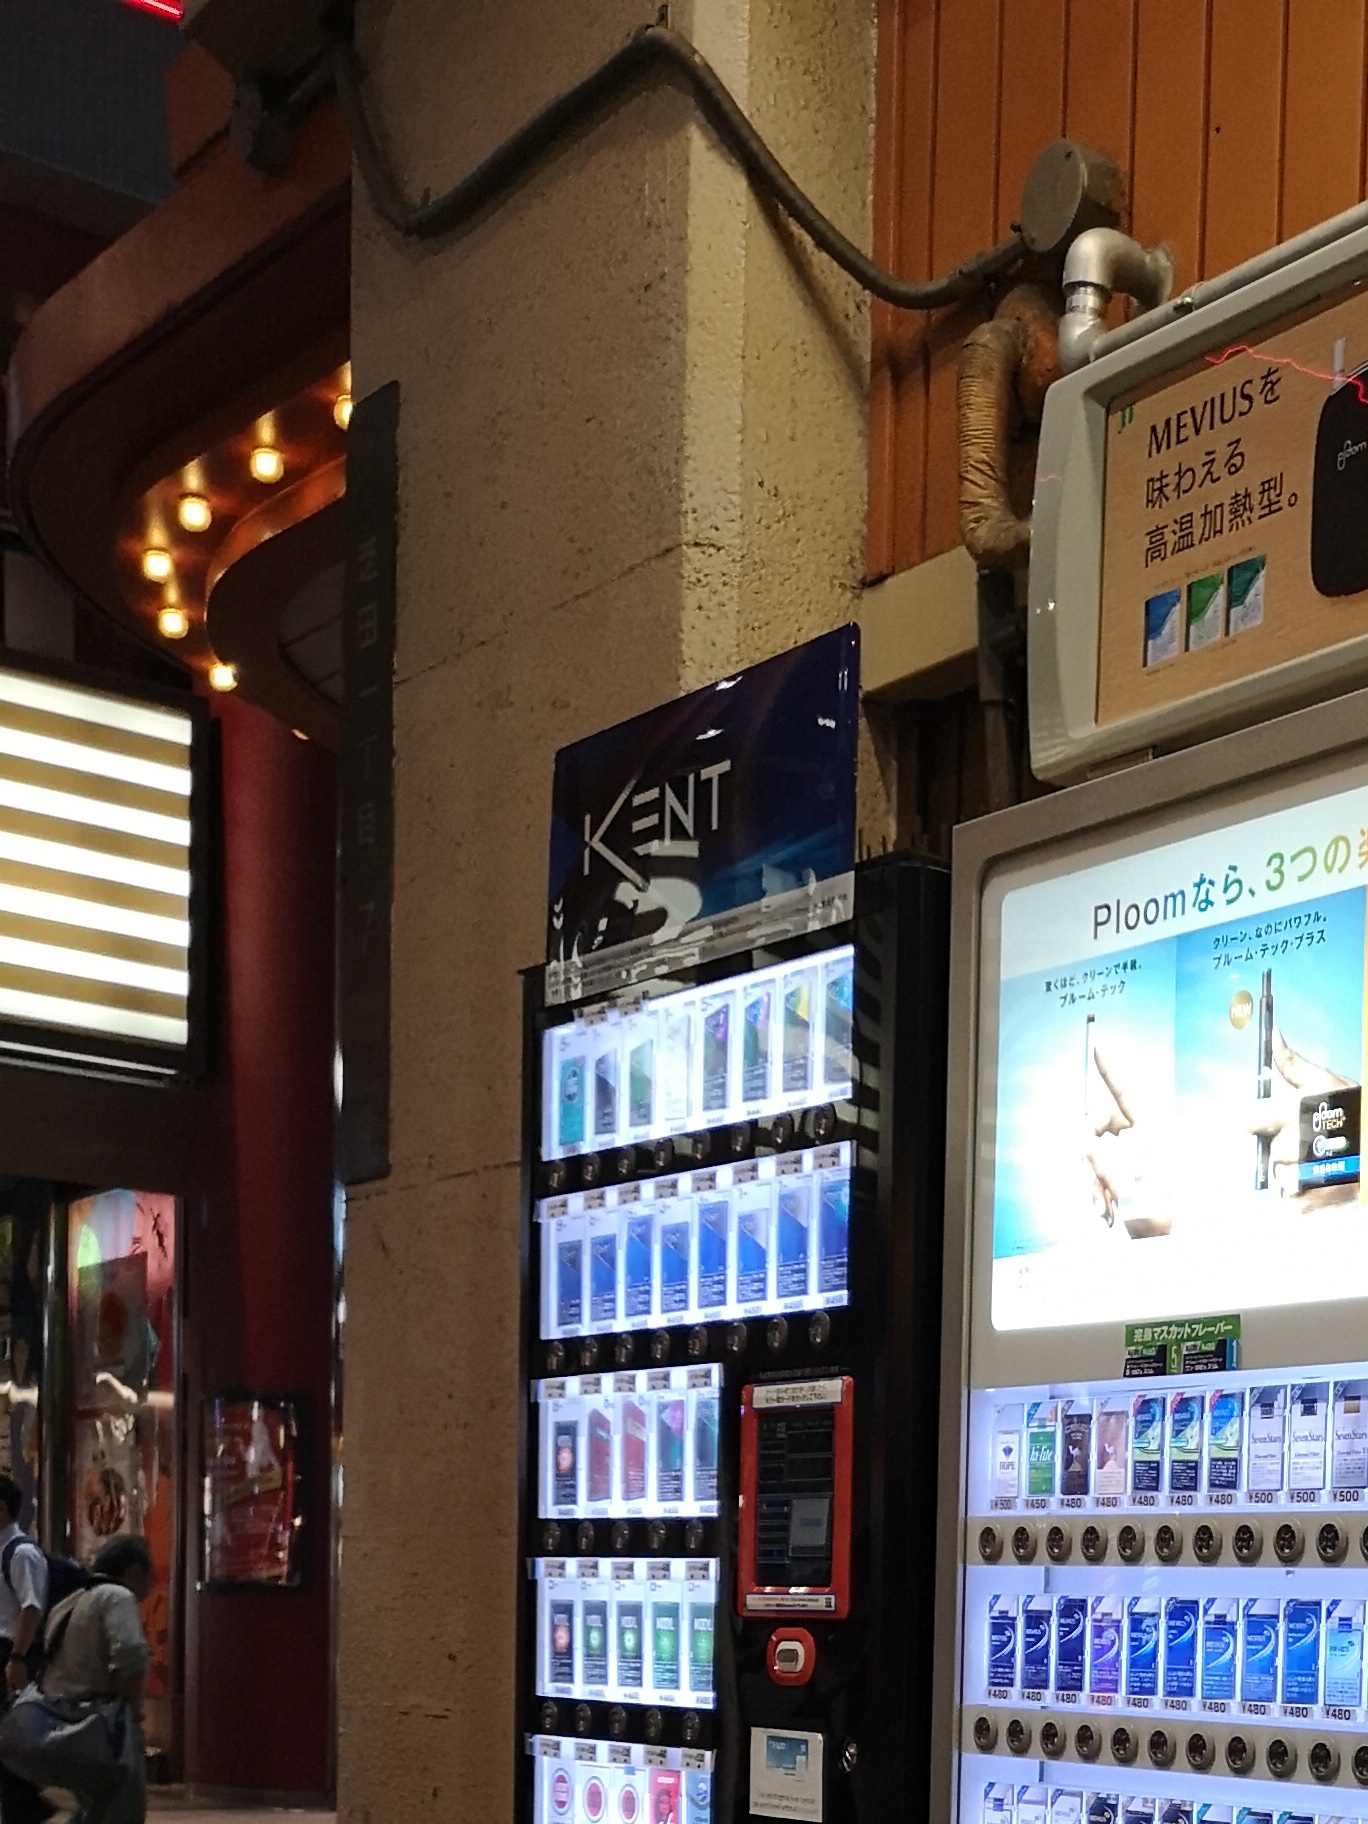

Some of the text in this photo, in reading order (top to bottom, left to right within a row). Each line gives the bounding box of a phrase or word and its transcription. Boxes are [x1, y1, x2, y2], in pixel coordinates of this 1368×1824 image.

[1144, 472, 1298, 568] 高温加熱型。
[1145, 438, 1245, 509] 味わえる
[583, 759, 732, 891] KENT
